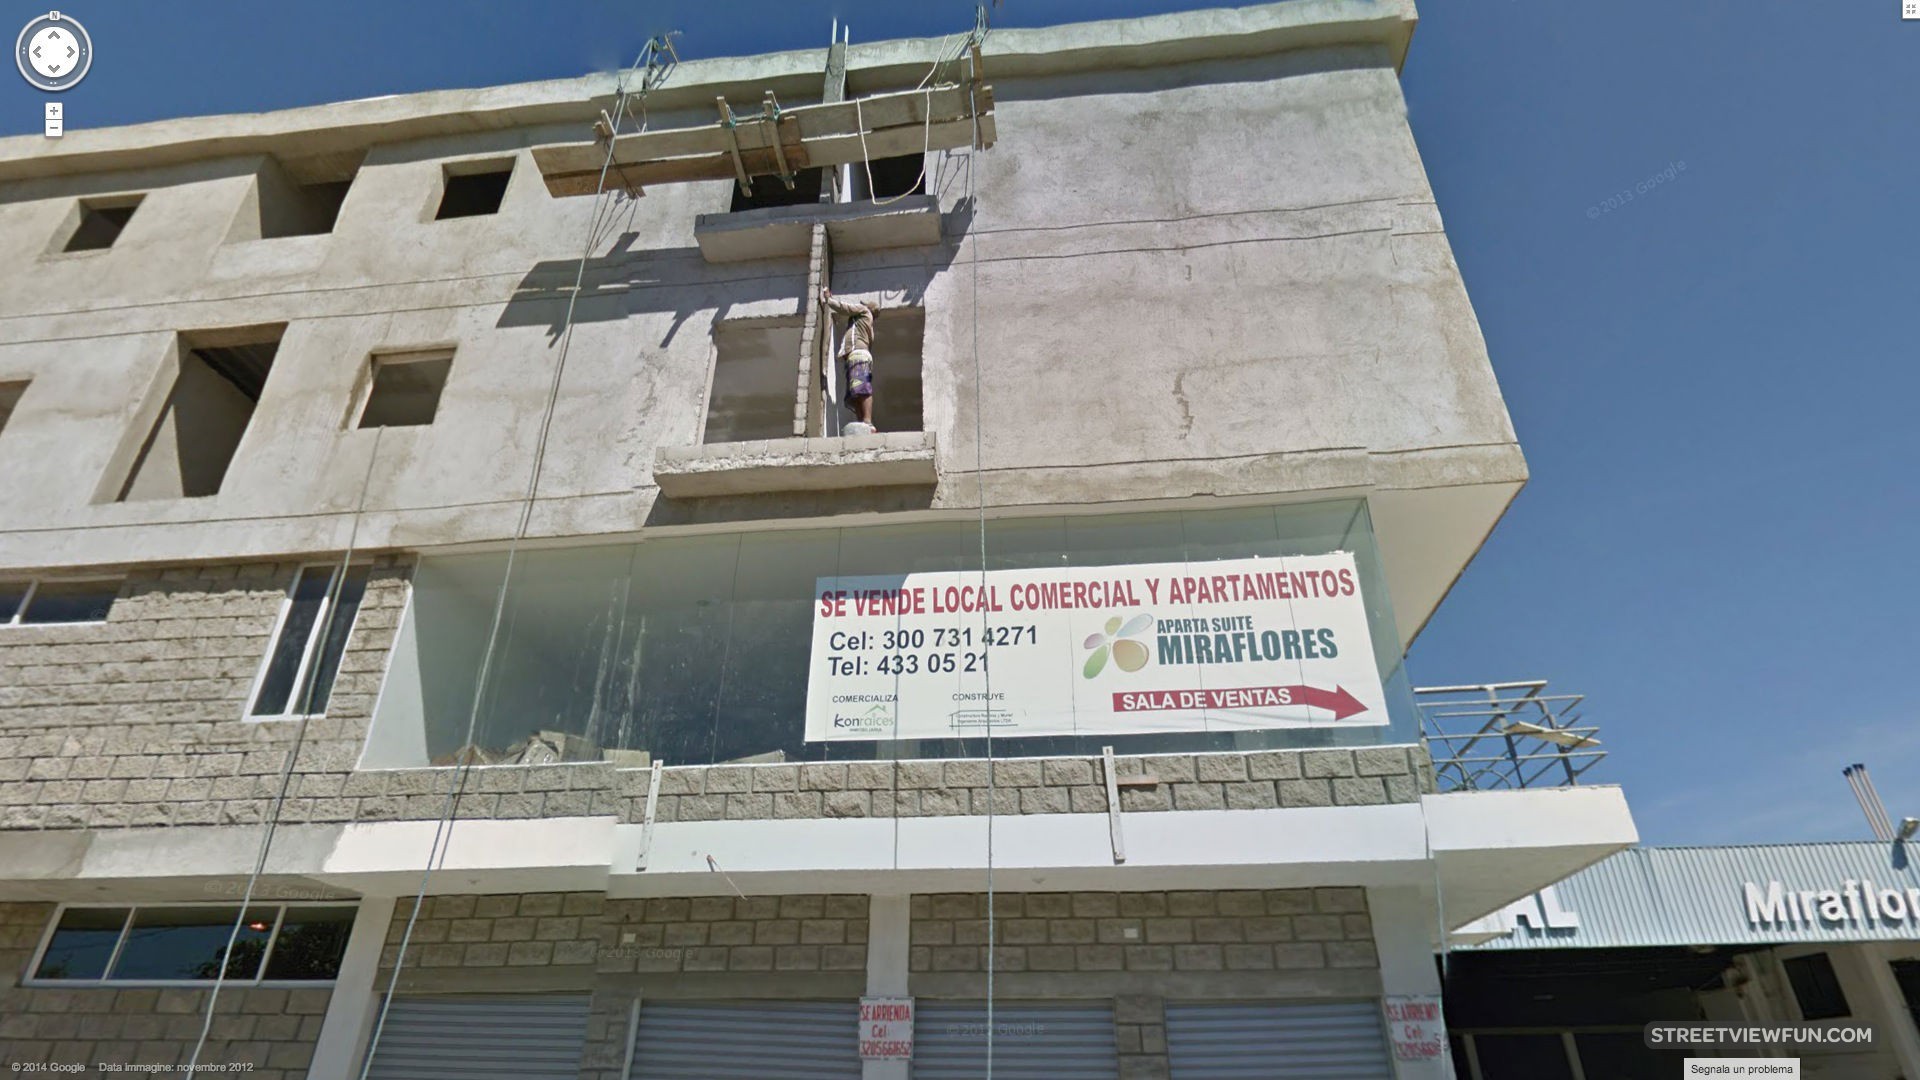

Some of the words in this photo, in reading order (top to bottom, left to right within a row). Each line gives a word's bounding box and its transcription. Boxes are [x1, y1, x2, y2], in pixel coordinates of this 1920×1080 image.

[820, 590, 847, 618] SE
[854, 587, 925, 617] VENDE
[933, 585, 1003, 613] LOCAL
[1009, 579, 1141, 612] COMERCIAL
[1145, 578, 1160, 605] Y
[1169, 568, 1355, 605] APARTAMENTOS
[1157, 617, 1209, 634] APARTA
[1212, 615, 1254, 632] SUITE
[830, 631, 874, 651] Cel:
[883, 629, 924, 649] 300
[933, 628, 972, 647] 731
[982, 625, 1037, 647] 4271
[1157, 627, 1338, 665] MIRAFLORES
[828, 656, 869, 676] Tel:
[877, 654, 919, 676] 433
[927, 653, 956, 673] 05
[964, 653, 988, 672] 21
[832, 694, 898, 703] COMERCIALIZA
[952, 693, 1005, 701] CONSTRUYE
[1123, 692, 1177, 710] SALA
[1180, 692, 1206, 708] DE
[1211, 688, 1292, 707] VENTAS
[860, 1005, 871, 1021] SE
[872, 1004, 911, 1021] ARRIENDA
